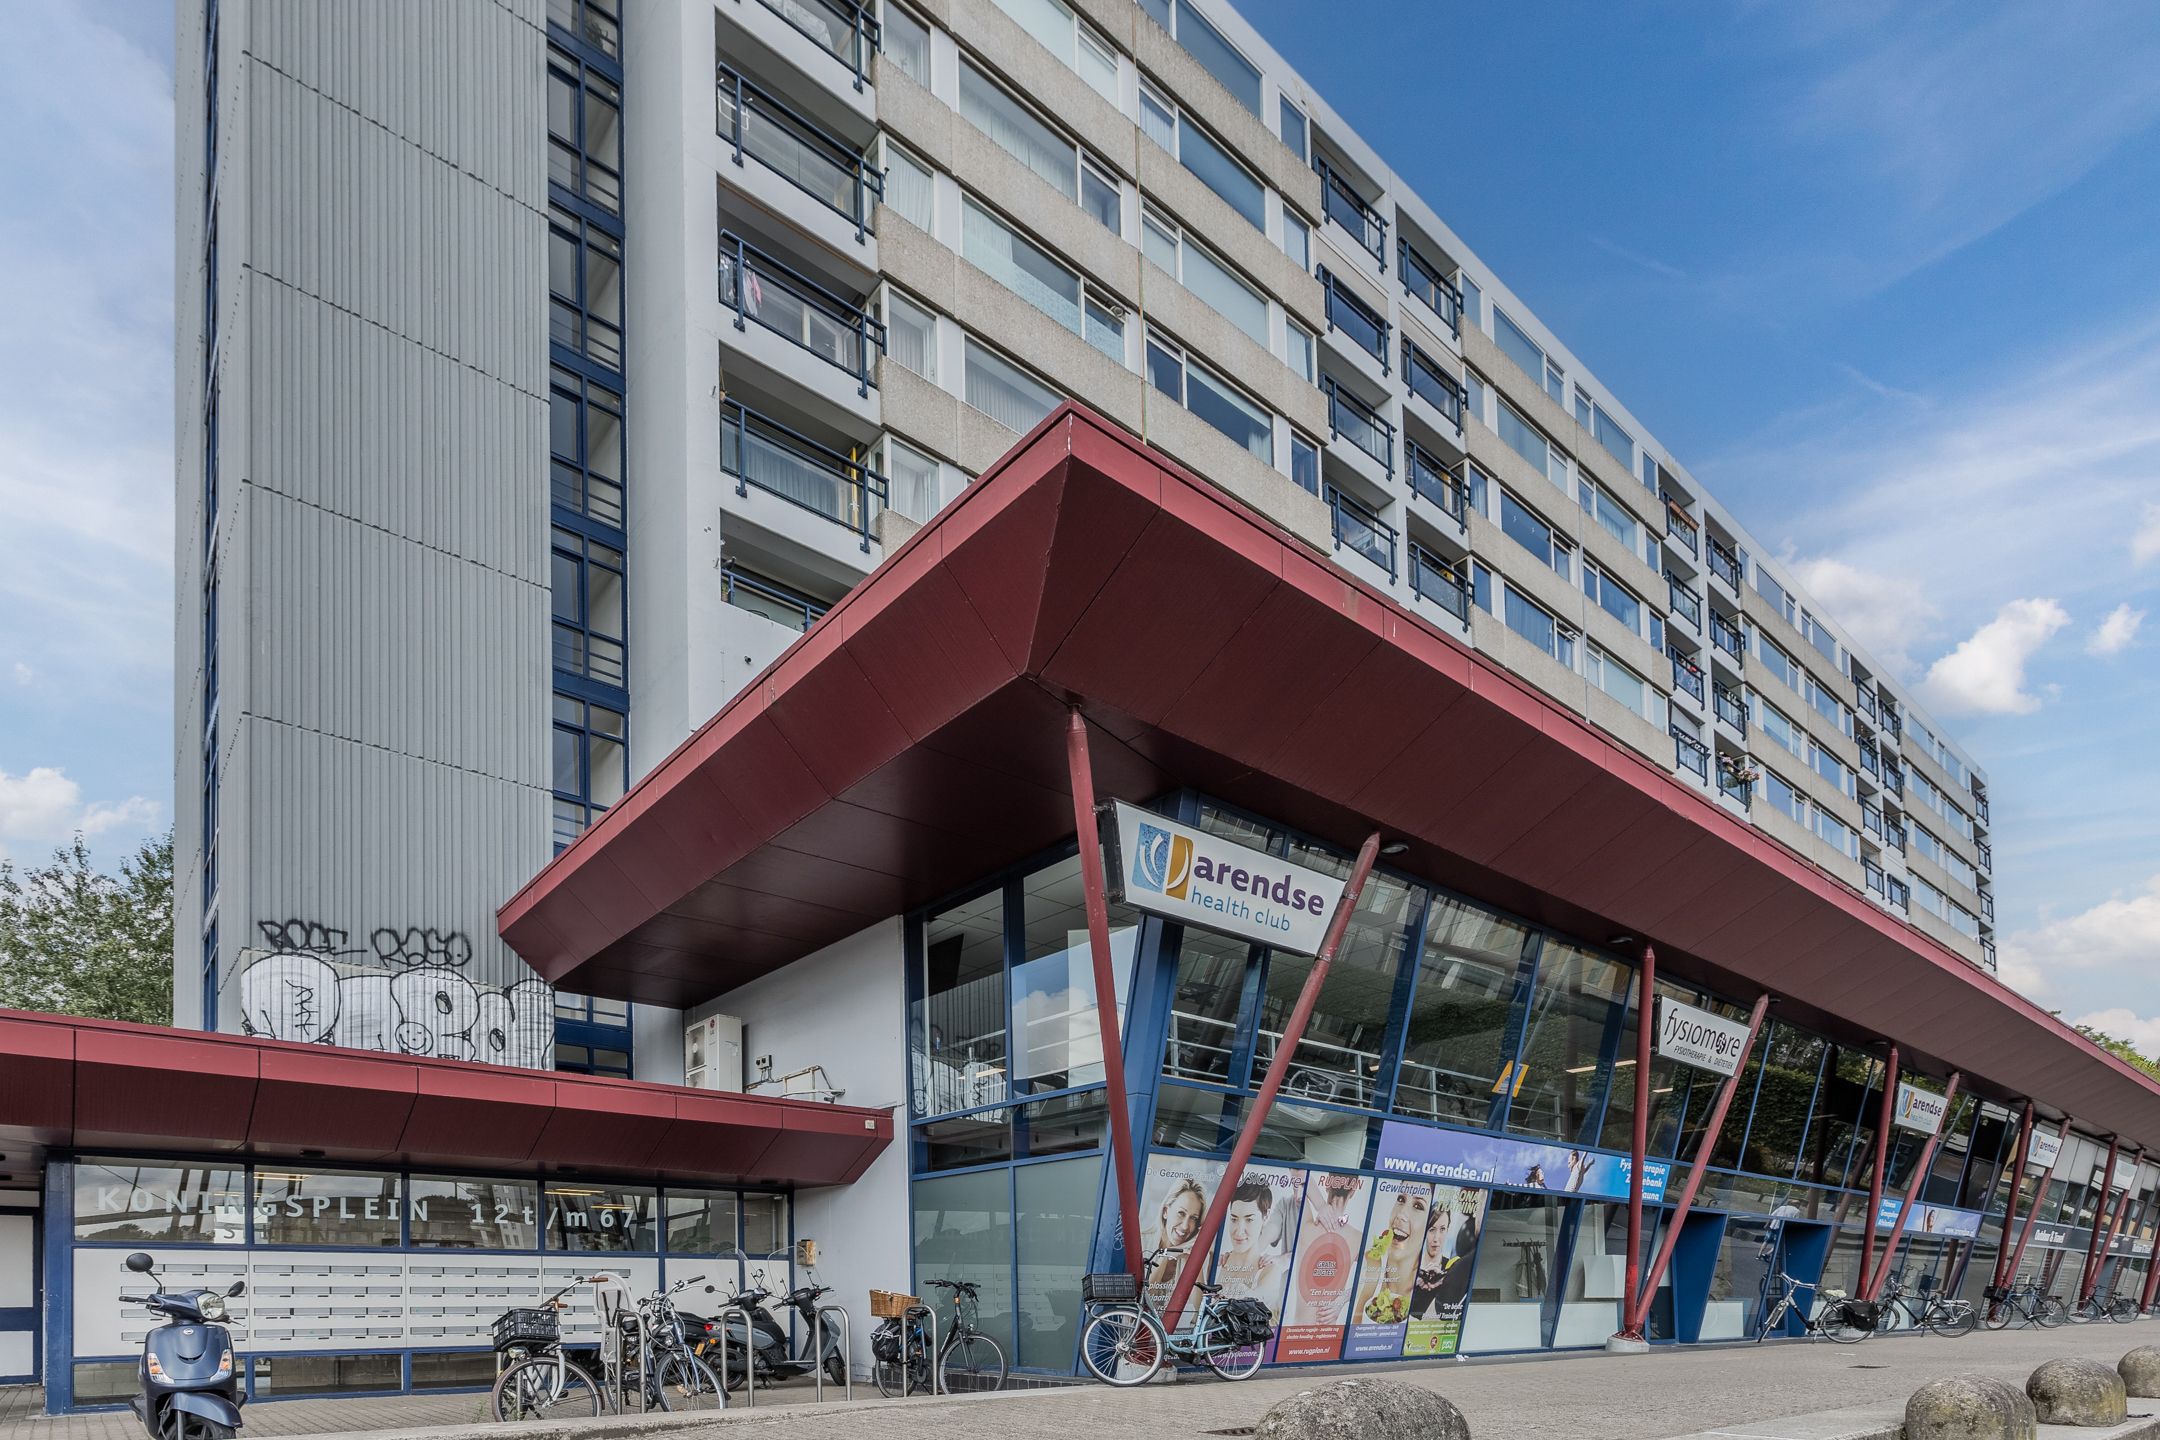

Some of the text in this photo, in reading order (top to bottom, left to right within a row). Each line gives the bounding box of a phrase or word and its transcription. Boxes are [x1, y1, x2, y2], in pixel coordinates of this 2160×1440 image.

[1193, 855, 1325, 916] arendse
[1191, 886, 1291, 931] health club
[1664, 1008, 1741, 1057] fysiomore
[1912, 1099, 1943, 1117] arendse
[1159, 1169, 1194, 1180] Gezonde
[1384, 1156, 1495, 1183] www.arendse.nl
[1619, 1159, 1666, 1176] Fyserapie
[1237, 1171, 1302, 1189] ysiomore
[1317, 1175, 1364, 1190] RUGPLAN
[1380, 1182, 1431, 1196] Gewichtplan
[1624, 1174, 1663, 1188] Zebank
[97, 1186, 429, 1222] KONINGSPLEIN
[1288, 1347, 1330, 1356] www.rugplan.nl
